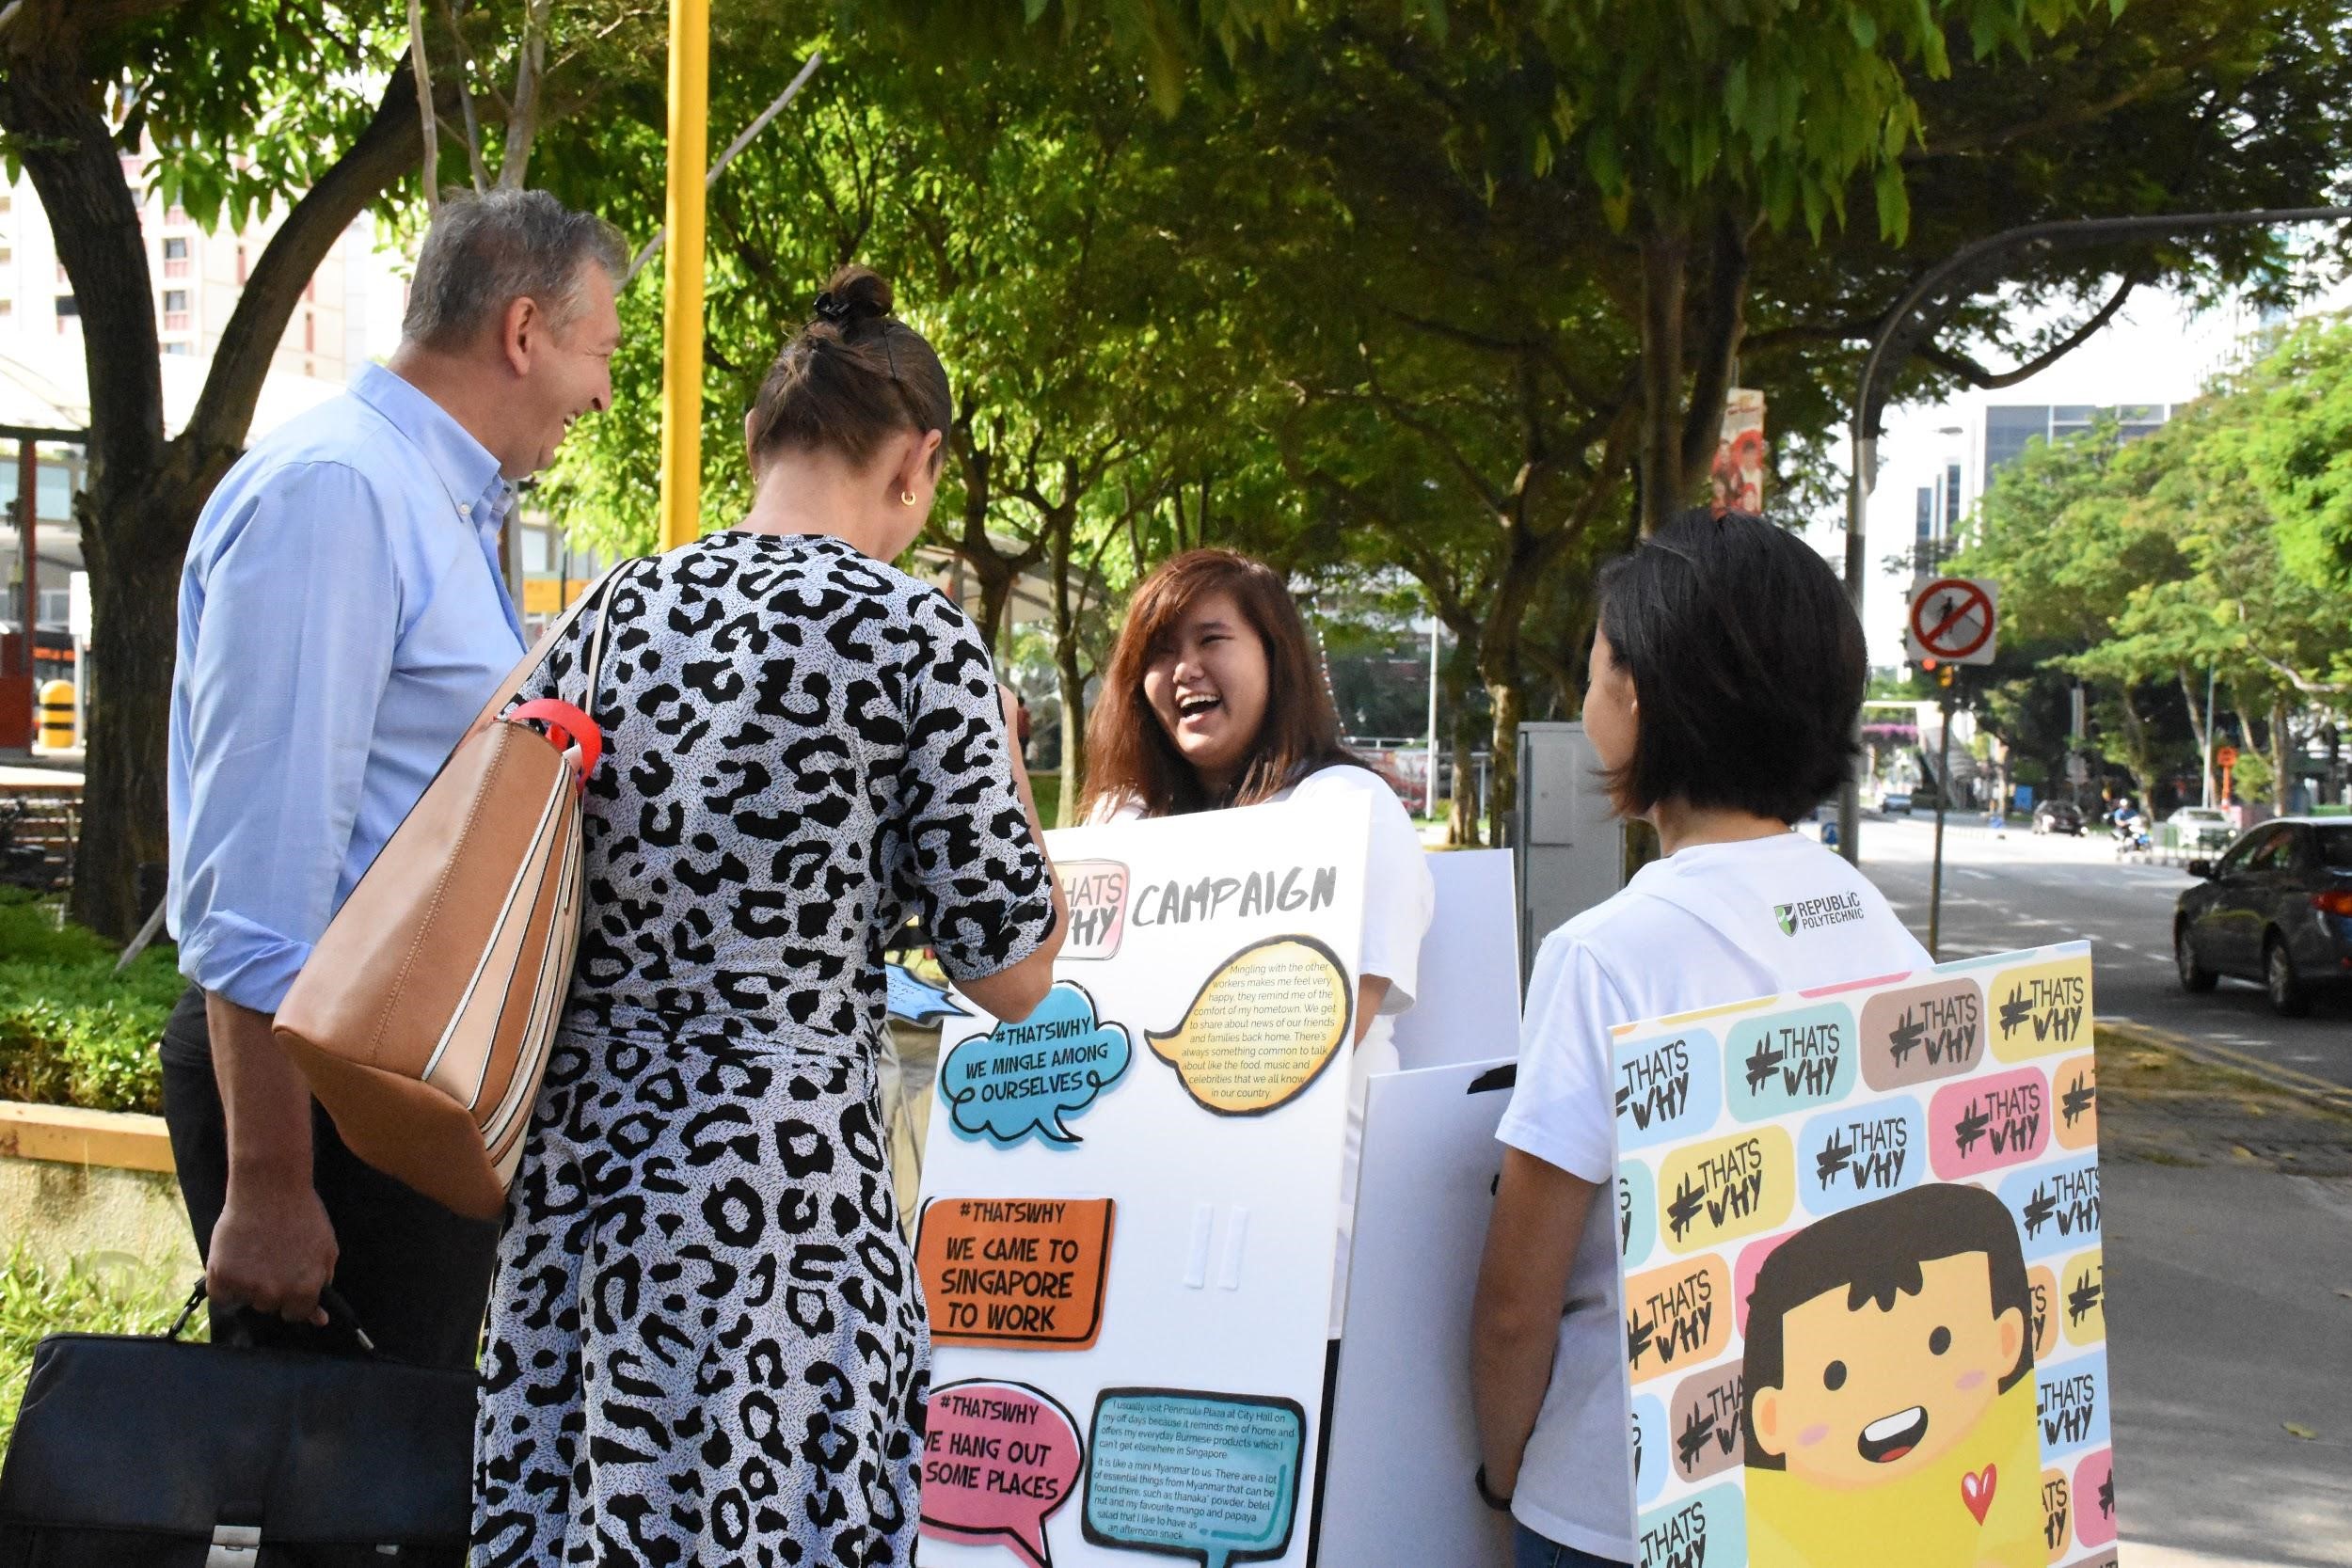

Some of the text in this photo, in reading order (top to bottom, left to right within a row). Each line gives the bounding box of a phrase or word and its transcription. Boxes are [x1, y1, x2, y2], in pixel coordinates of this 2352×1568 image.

[1062, 873, 1122, 907] HATS
[1132, 866, 1336, 927] CAMPAIGN
[1802, 909, 1864, 929] POLYTECHNIC
[1213, 978, 1245, 988] workers
[1248, 977, 1275, 987] makes
[1295, 976, 1311, 986] feel
[1312, 978, 1331, 987] very
[1231, 962, 1328, 975] Mingling with the other
[1194, 1006, 1225, 1016] comfort
[1228, 1006, 1236, 1014] of
[1239, 1006, 1251, 1017] my
[1305, 1004, 1318, 1012] We
[1321, 1004, 1336, 1015] get
[1238, 991, 1255, 1002] they
[1259, 990, 1288, 1000] remind
[1308, 990, 1317, 999] of
[1319, 990, 1333, 999] the
[996, 1017, 1090, 1046] #THATSWHY
[1190, 1021, 1198, 1029] to
[1200, 1020, 1222, 1029] share
[1225, 1019, 1248, 1028] about
[1251, 1019, 1273, 1027] news
[1276, 1018, 1285, 1027] of
[1303, 1018, 1334, 1026] friends
[1207, 1034, 1239, 1042] families
[1242, 1033, 1262, 1041] back
[2033, 1006, 2082, 1042] WHY
[1182, 1046, 1327, 1058] always something common to talk
[1925, 1024, 1976, 1065] WHY
[966, 1043, 1108, 1079] WE MINGLE AMONG
[1183, 1061, 1205, 1069] about
[1208, 1061, 1221, 1069] like
[1293, 1060, 1310, 1069] and
[1784, 1056, 1837, 1096] WHY
[982, 1071, 1082, 1102] OURSELVES
[1234, 1074, 1251, 1083] that
[1268, 1074, 1279, 1083] all
[1281, 1074, 1306, 1083] know
[1631, 1072, 1689, 1131] WHY
[1990, 1114, 2039, 1155] WHY
[1852, 1149, 1905, 1189] WHY
[961, 1202, 1066, 1223] #THATSWHY
[1707, 1170, 1761, 1228] WHY
[946, 1237, 1078, 1263] WE CAME TO
[941, 1268, 1073, 1298] SINGAPORE
[948, 1302, 1056, 1332] TO WORK
[1656, 1302, 1711, 1363] WHY
[941, 1395, 1039, 1425] #THATSWHY
[2044, 1403, 2092, 1446] WHY
[950, 1433, 1001, 1460] HANG
[1009, 1441, 1051, 1467] OUT
[926, 1462, 1058, 1499] SOME PLACES
